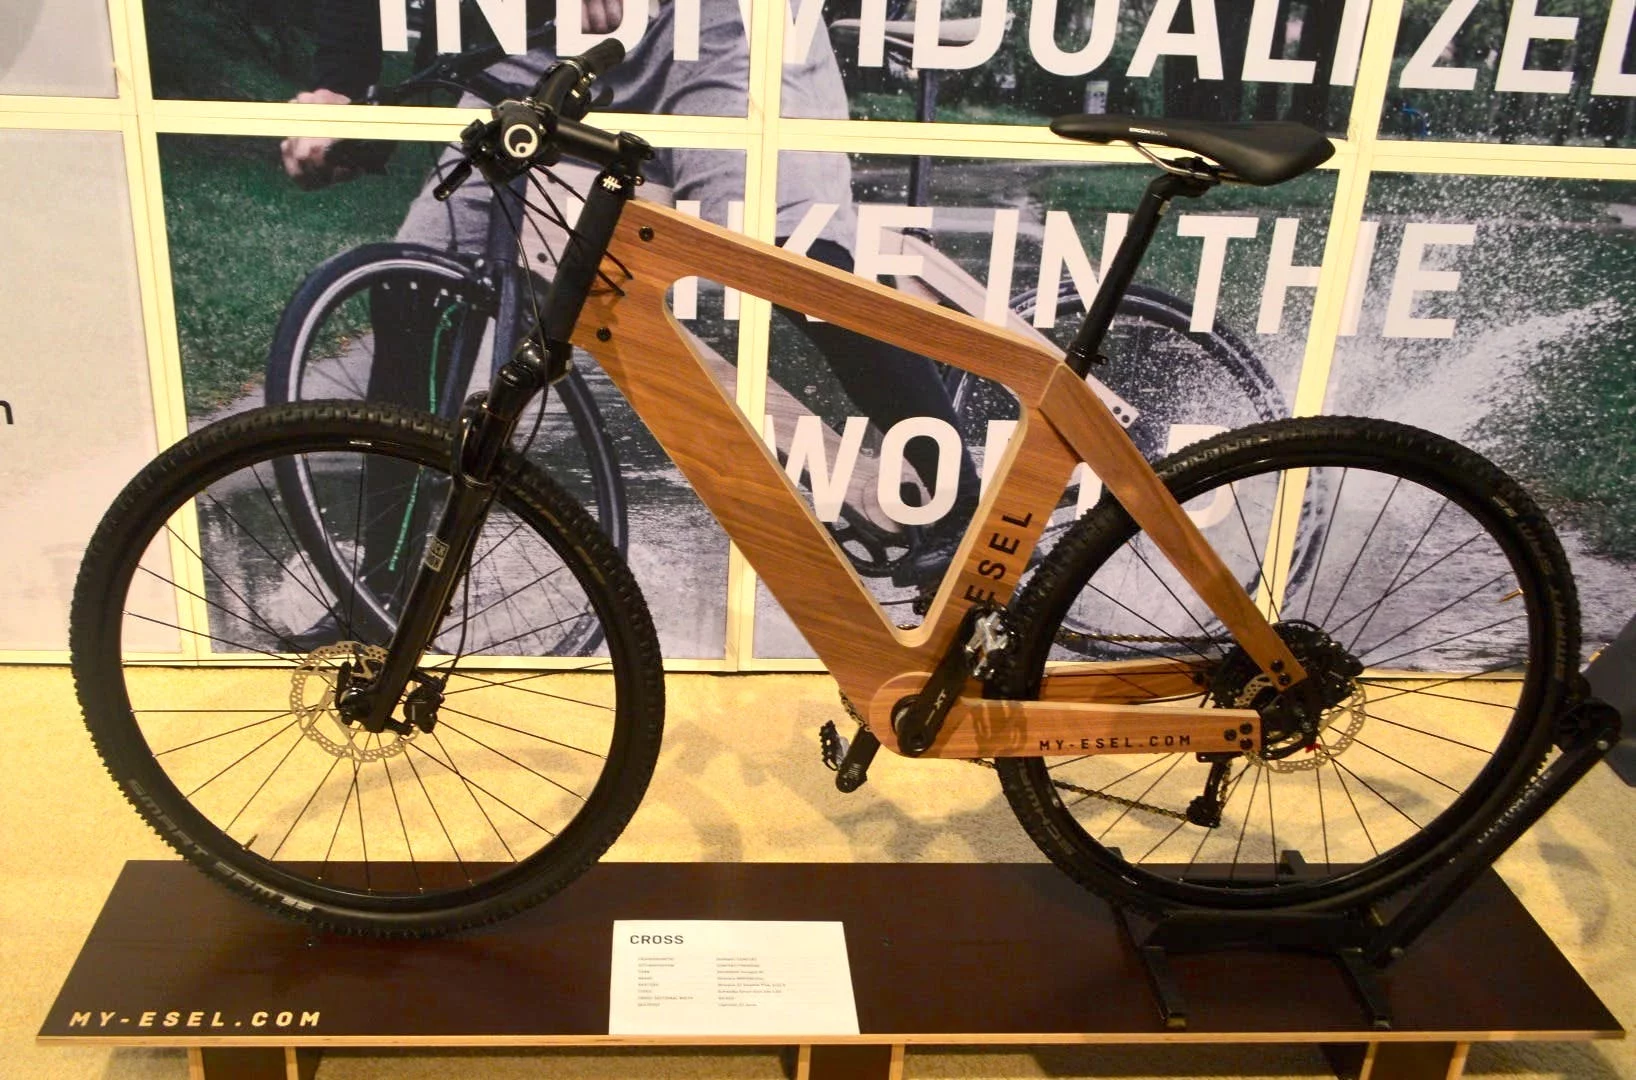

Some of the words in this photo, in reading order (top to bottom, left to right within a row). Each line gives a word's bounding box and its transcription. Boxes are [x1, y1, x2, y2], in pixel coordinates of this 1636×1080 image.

[1177, 214, 1478, 339] THE
[1039, 735, 1191, 751] MY-ESEL.COM
[629, 934, 685, 945] CROSS
[68, 1011, 321, 1028] MY-ESEL.COM
